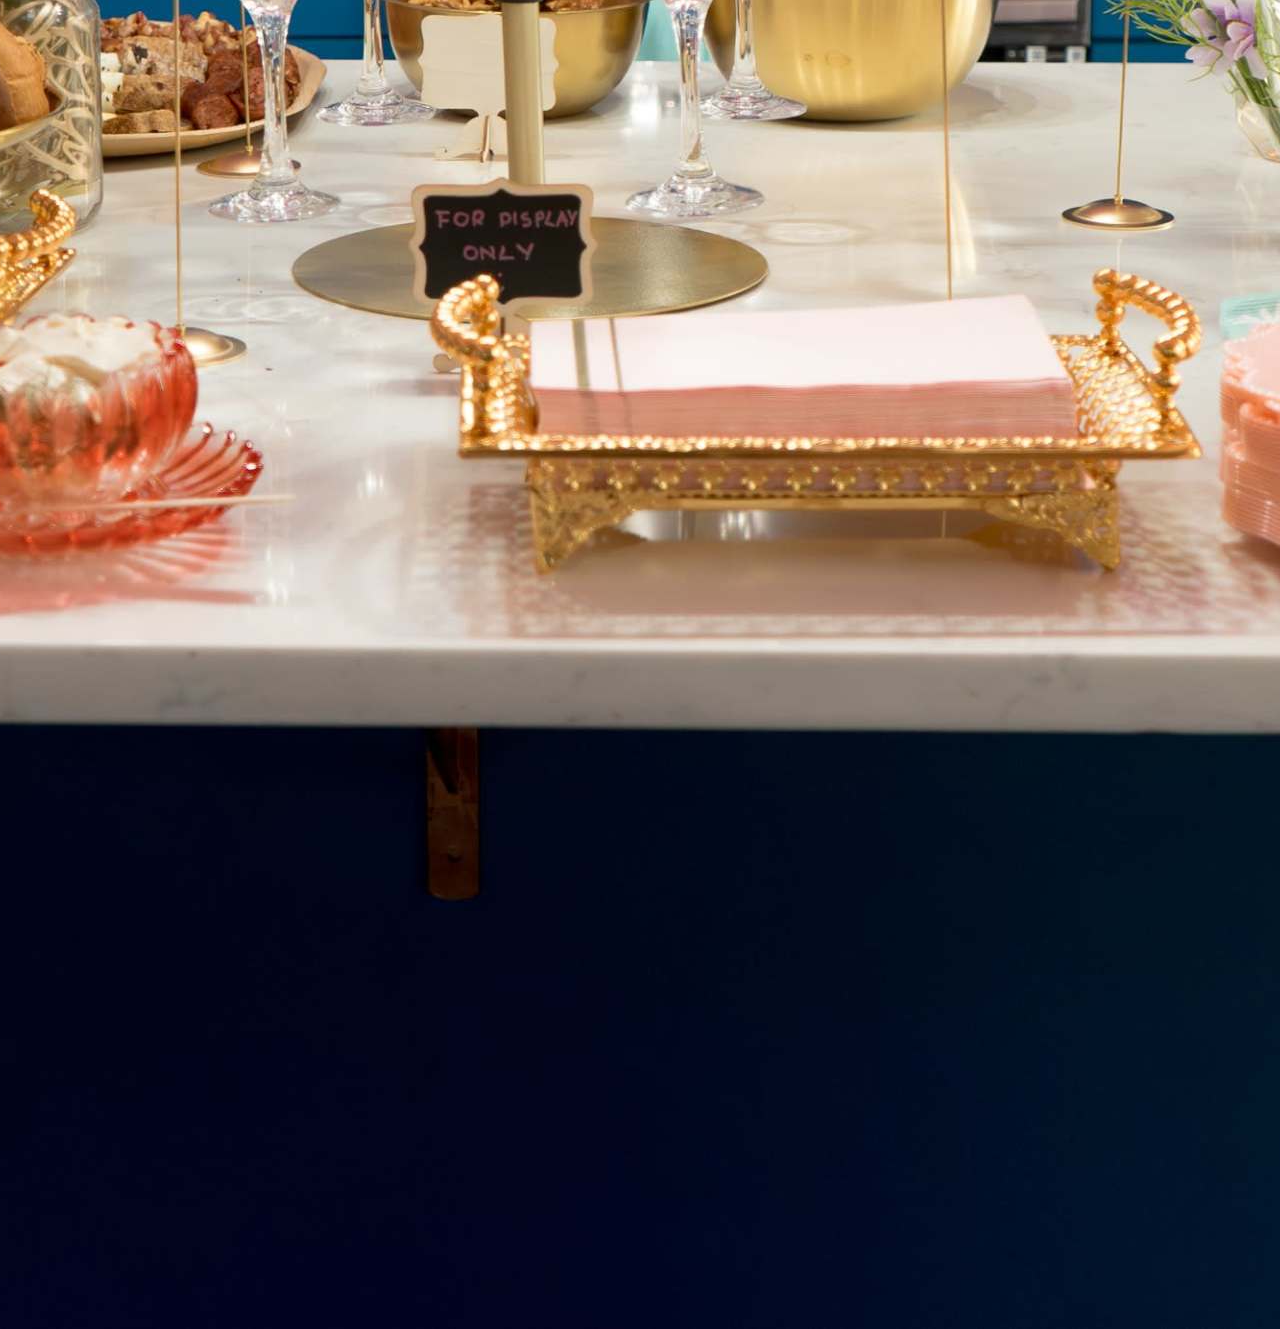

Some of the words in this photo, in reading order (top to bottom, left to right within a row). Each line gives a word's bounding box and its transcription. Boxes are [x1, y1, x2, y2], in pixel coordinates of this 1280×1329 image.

[435, 209, 486, 229] FOR
[498, 209, 579, 228] DISPLAY
[463, 242, 535, 262] ONLY
